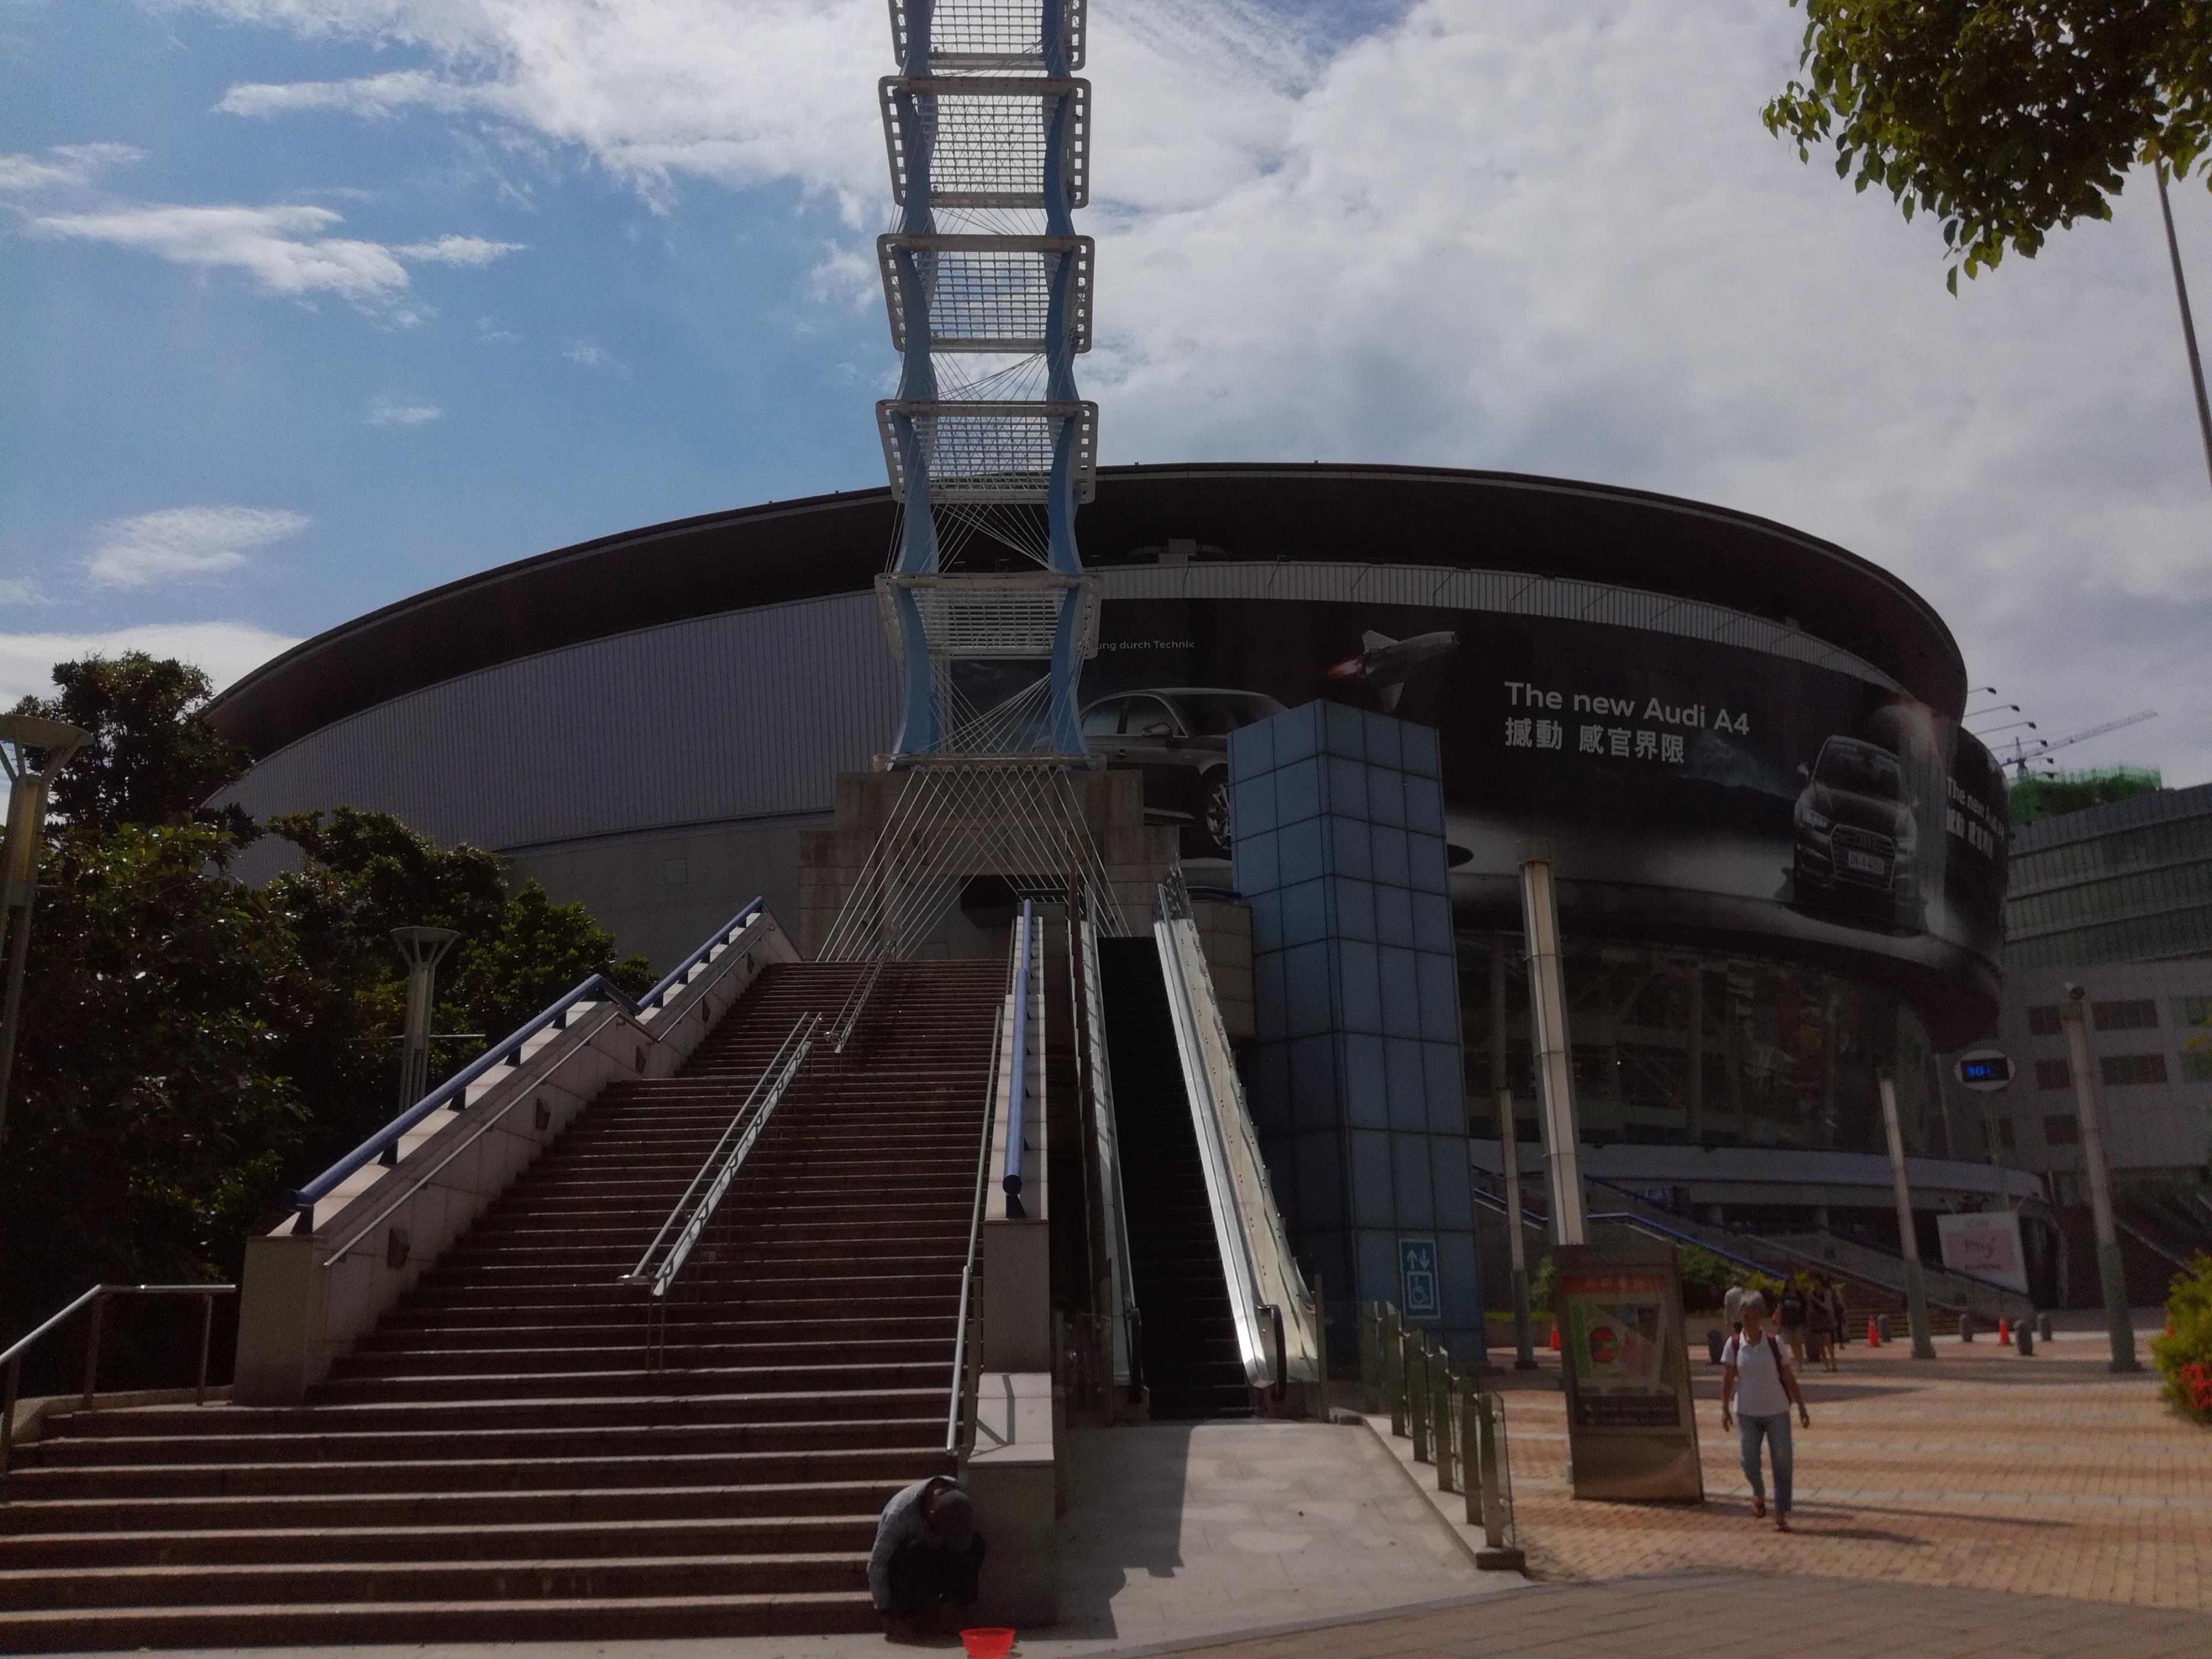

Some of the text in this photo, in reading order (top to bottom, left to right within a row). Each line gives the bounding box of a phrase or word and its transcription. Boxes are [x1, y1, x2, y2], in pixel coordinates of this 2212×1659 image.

[1097, 639, 1195, 651] ung durch Technik
[1504, 681, 1751, 735] The new Audi A4
[1504, 716, 1685, 765] 撼動 感官界限
[1946, 776, 1966, 805] The
